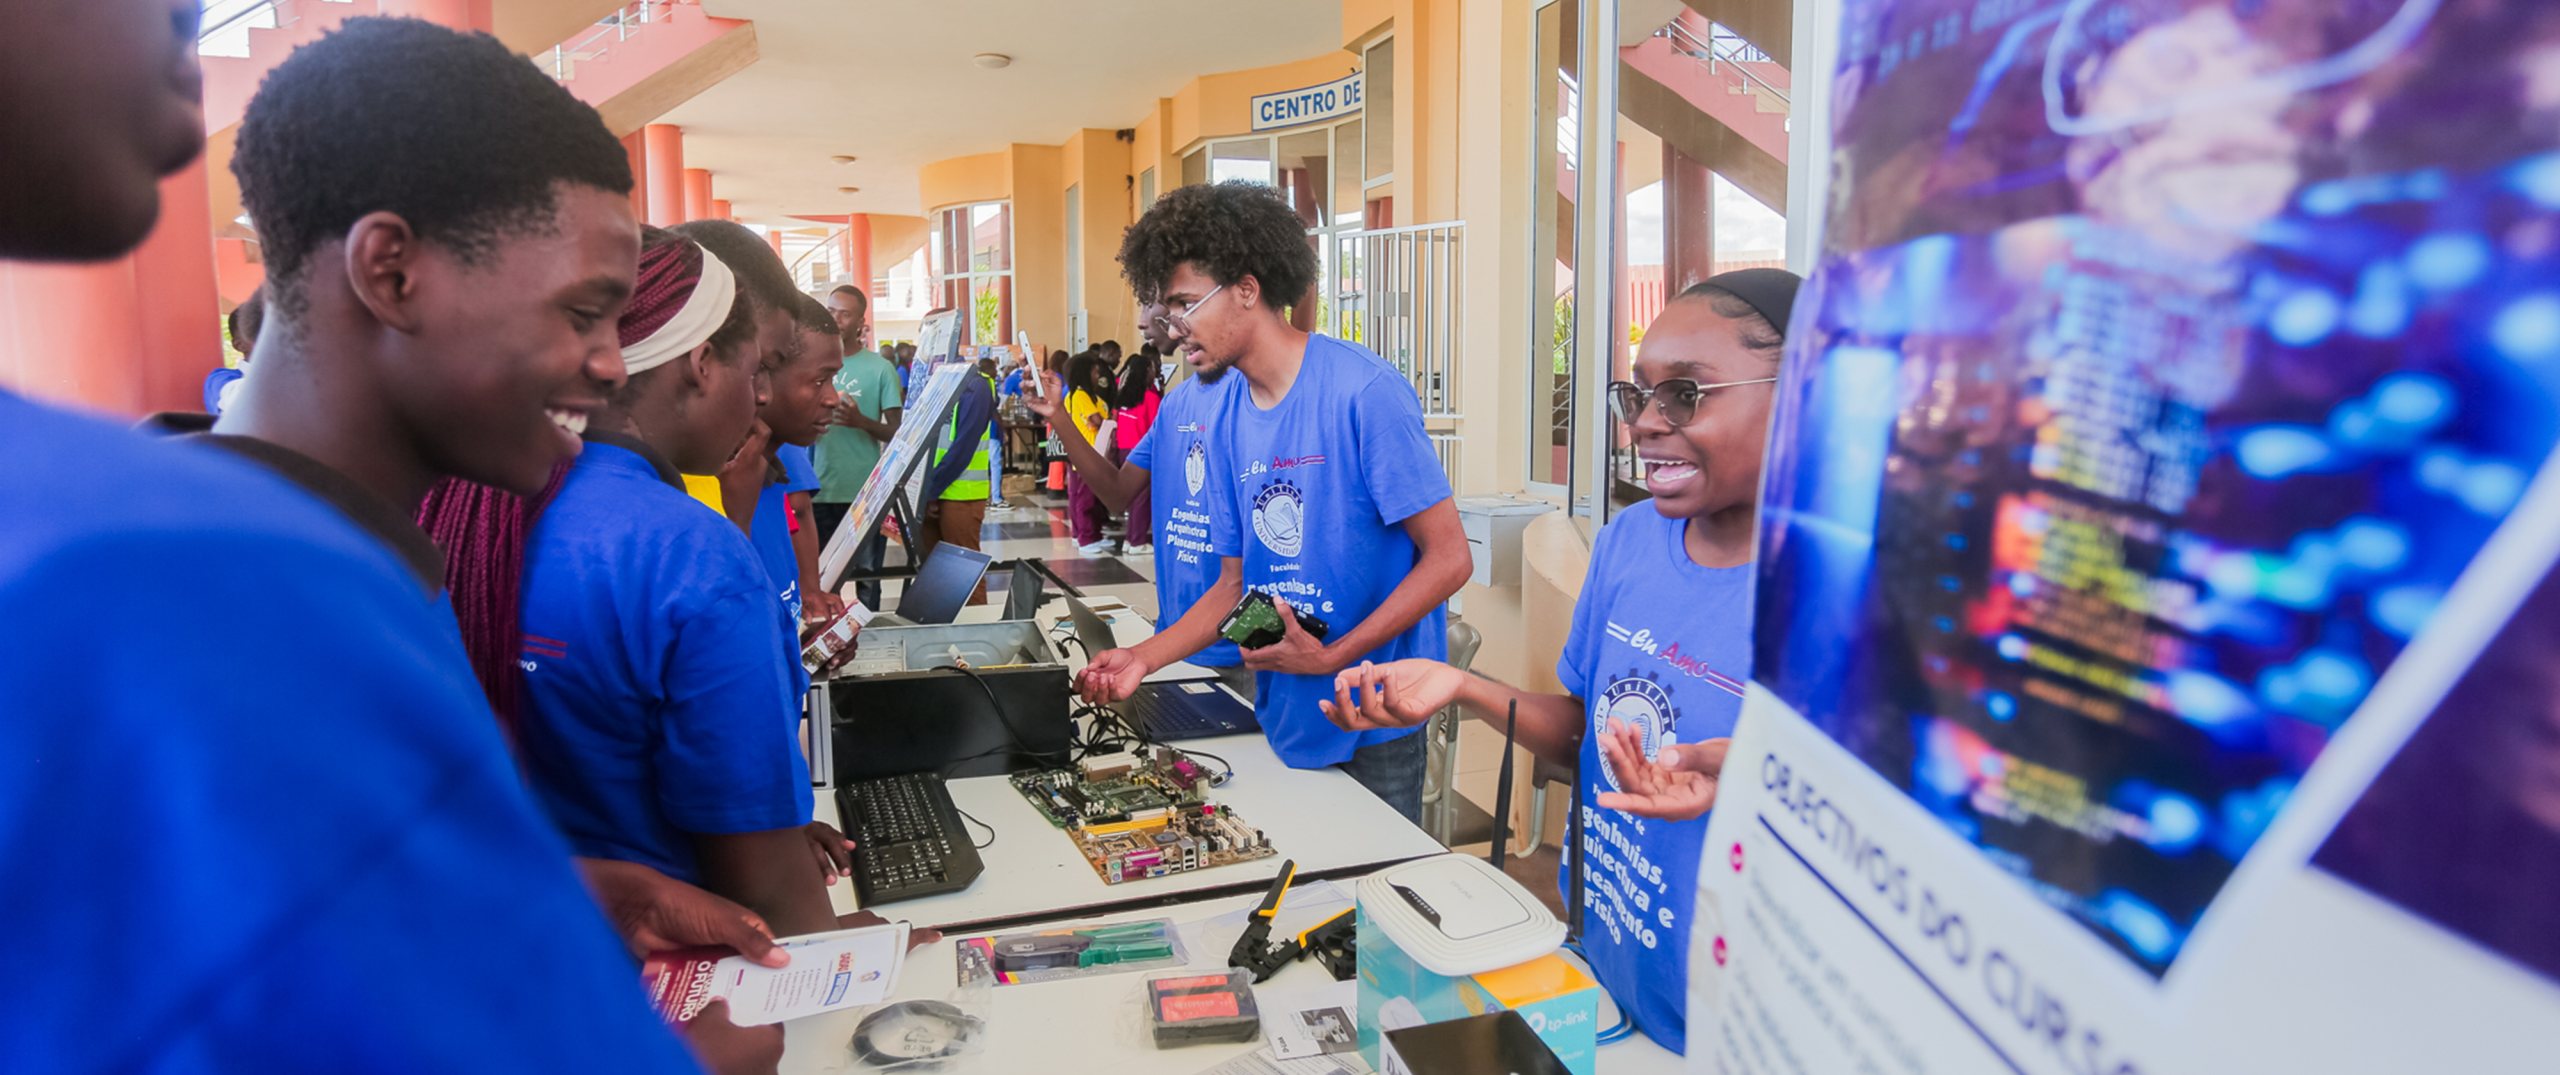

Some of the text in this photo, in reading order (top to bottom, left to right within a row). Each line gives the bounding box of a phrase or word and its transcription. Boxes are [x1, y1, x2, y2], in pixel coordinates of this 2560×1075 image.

[1261, 80, 1361, 122] CENTRO DE
[1271, 456, 1301, 472] Amo
[1322, 600, 1334, 613] e
[1657, 642, 1709, 678] Amo
[1611, 681, 1670, 724] UniTiva
[1571, 799, 1667, 894] genharias,
[1584, 887, 1621, 945] Físico
[1658, 907, 1674, 928] e
[1761, 752, 1909, 916] OBJECTIVOS
[1918, 885, 1973, 969] DO
[1981, 948, 2145, 1075] CURS
[679, 960, 712, 1022] O FUTURO
[1548, 1009, 1589, 1033] tp-link
